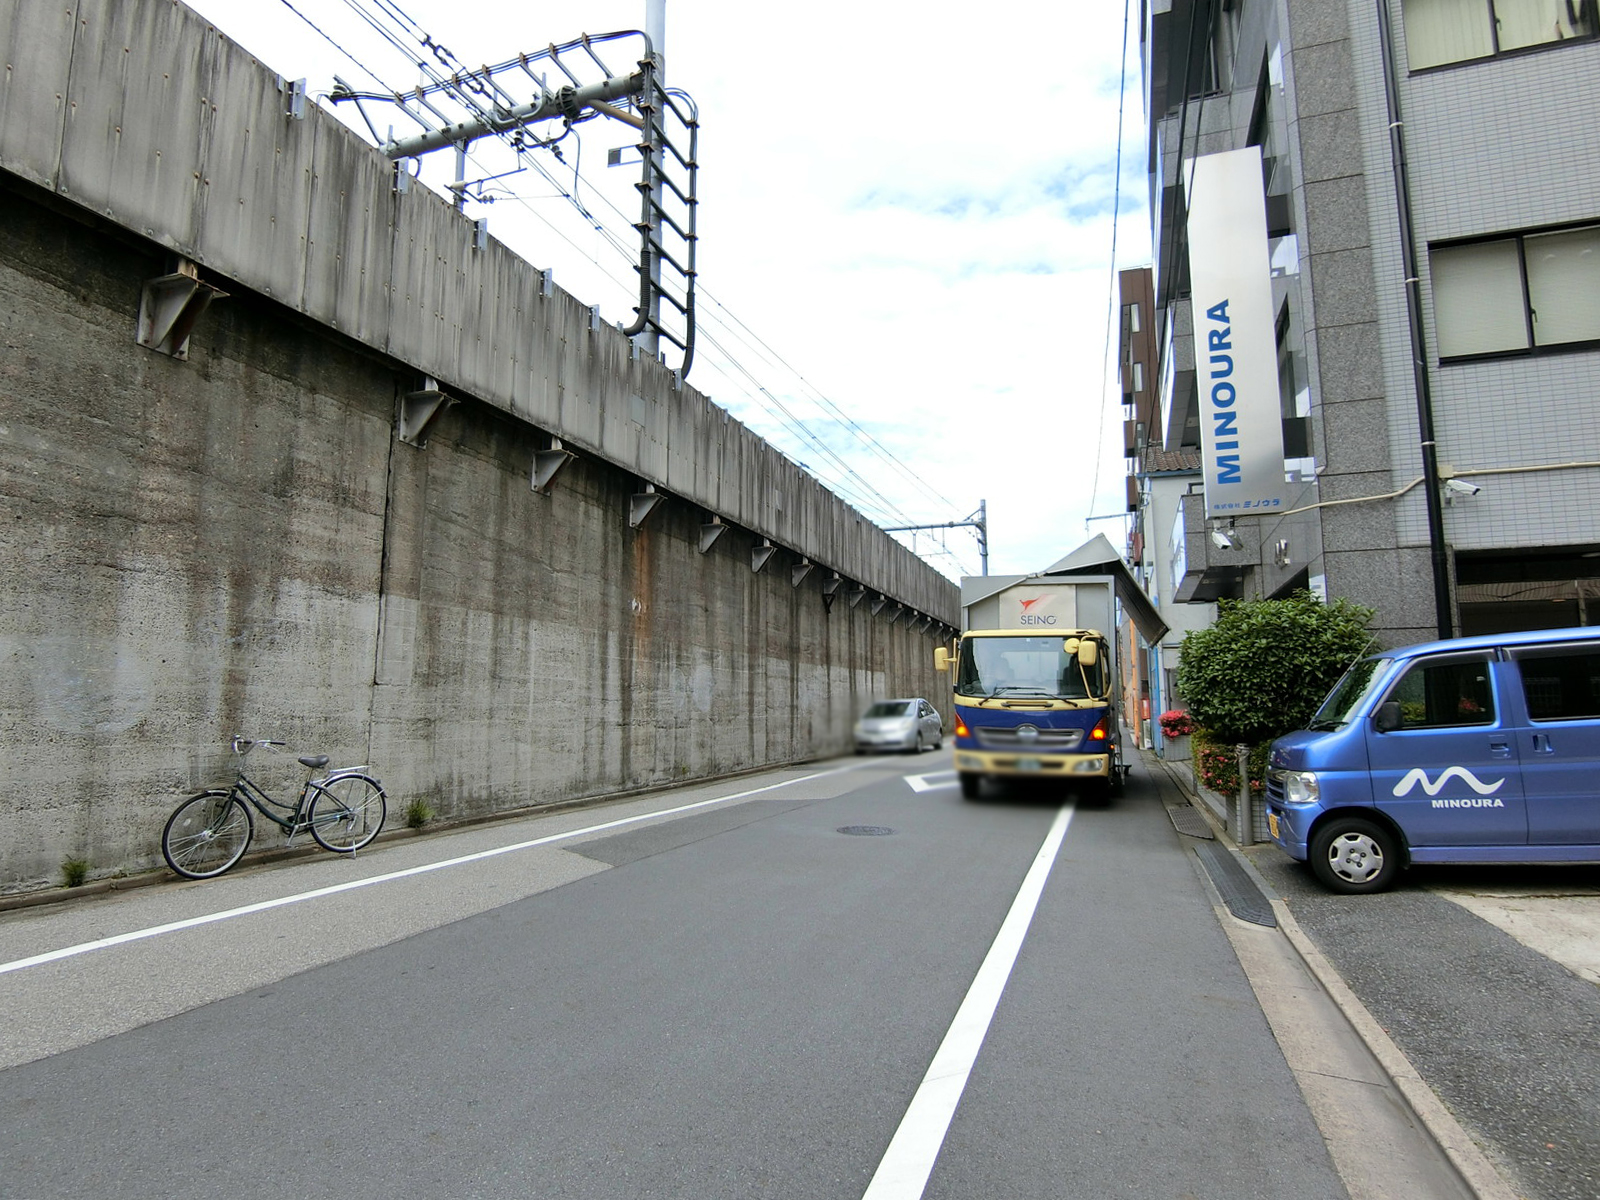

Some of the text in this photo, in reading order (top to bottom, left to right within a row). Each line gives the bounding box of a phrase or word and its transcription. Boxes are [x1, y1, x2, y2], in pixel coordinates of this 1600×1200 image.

[1207, 299, 1241, 484] MINOURA
[1243, 498, 1280, 508] ミノウラ
[1020, 615, 1057, 625] SEINO
[1431, 799, 1504, 809] MINOURA
